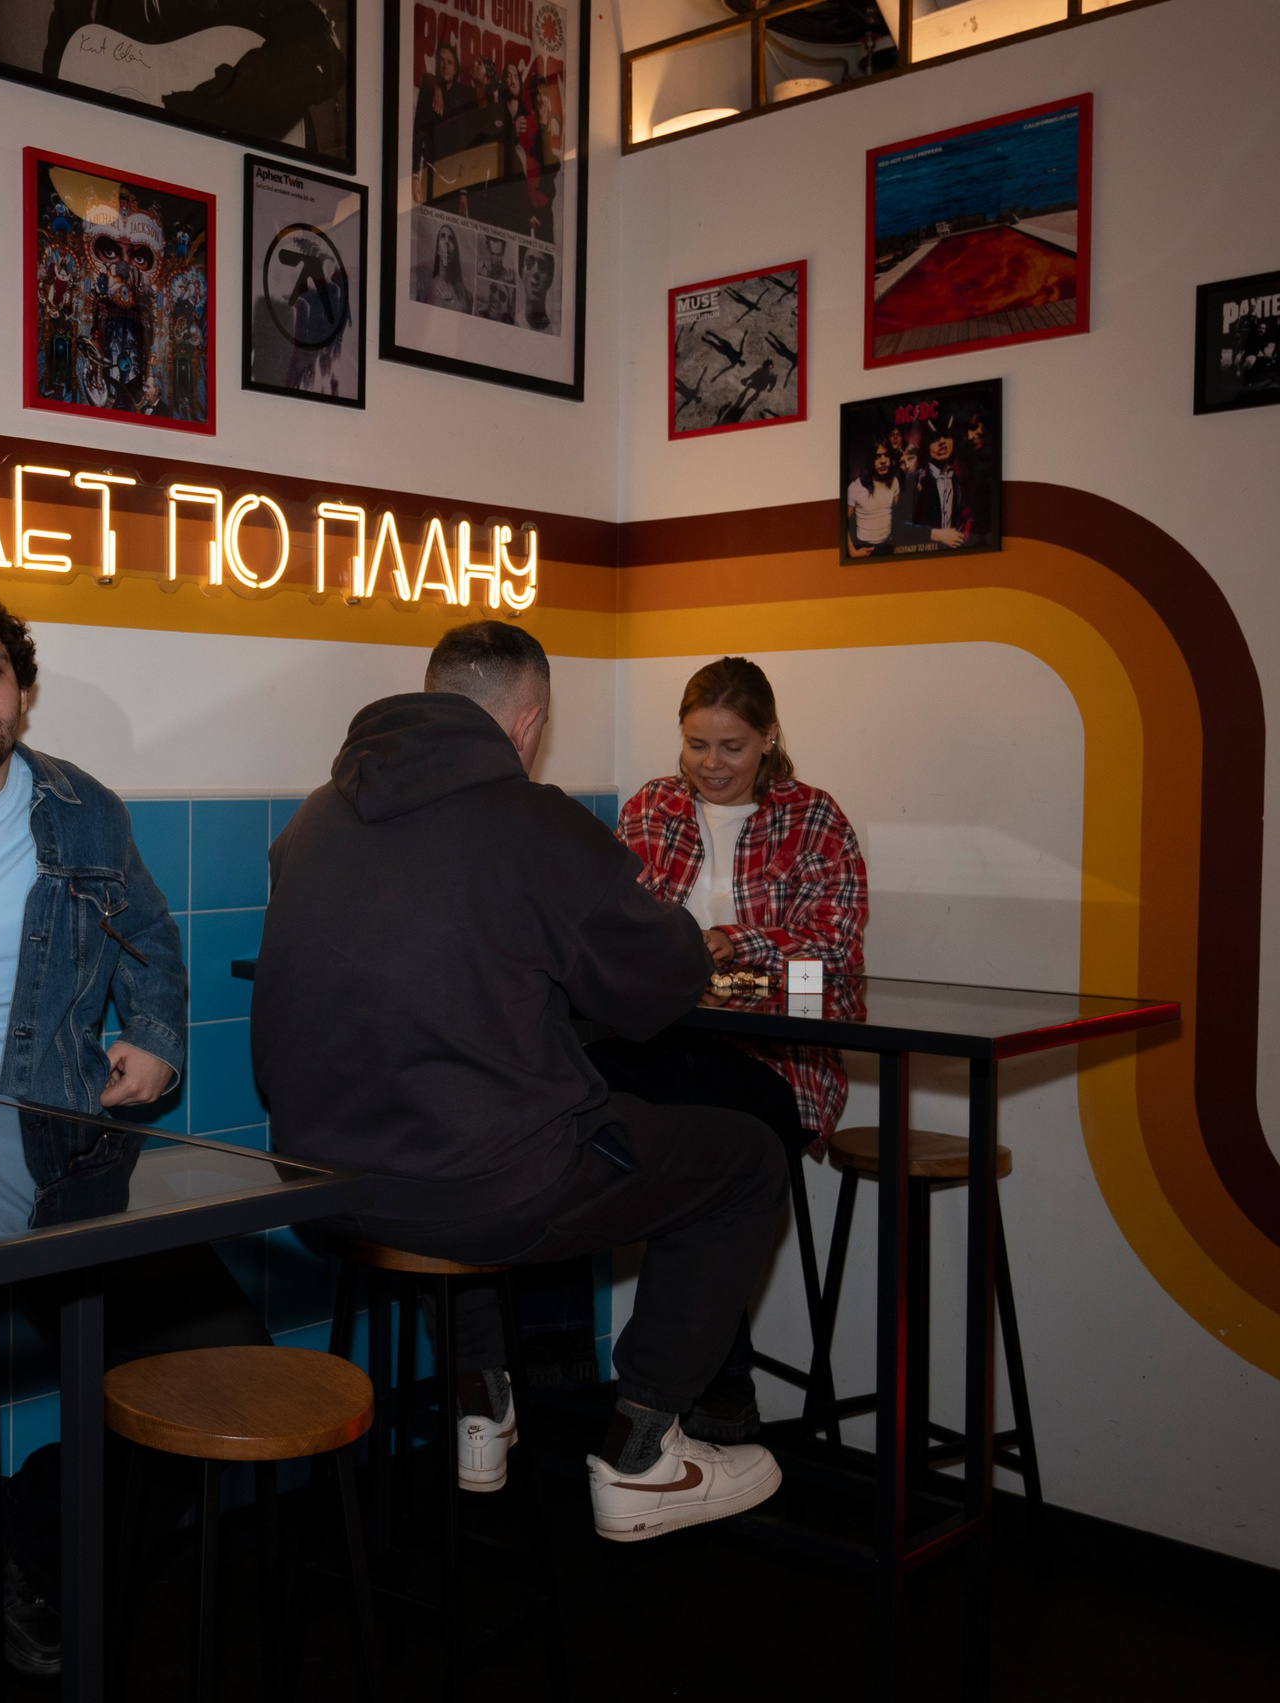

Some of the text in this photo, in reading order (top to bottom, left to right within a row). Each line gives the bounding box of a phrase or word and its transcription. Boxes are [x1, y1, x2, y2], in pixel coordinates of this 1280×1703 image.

[256, 167, 304, 189] Aphex Twin
[129, 222, 160, 242] JACKSON
[677, 292, 719, 312] MUSE
[677, 311, 720, 325] ABSOLUTION
[168, 482, 290, 589] ПО
[317, 501, 538, 611] ПЛАНУ
[633, 1523, 646, 1532] AIR
